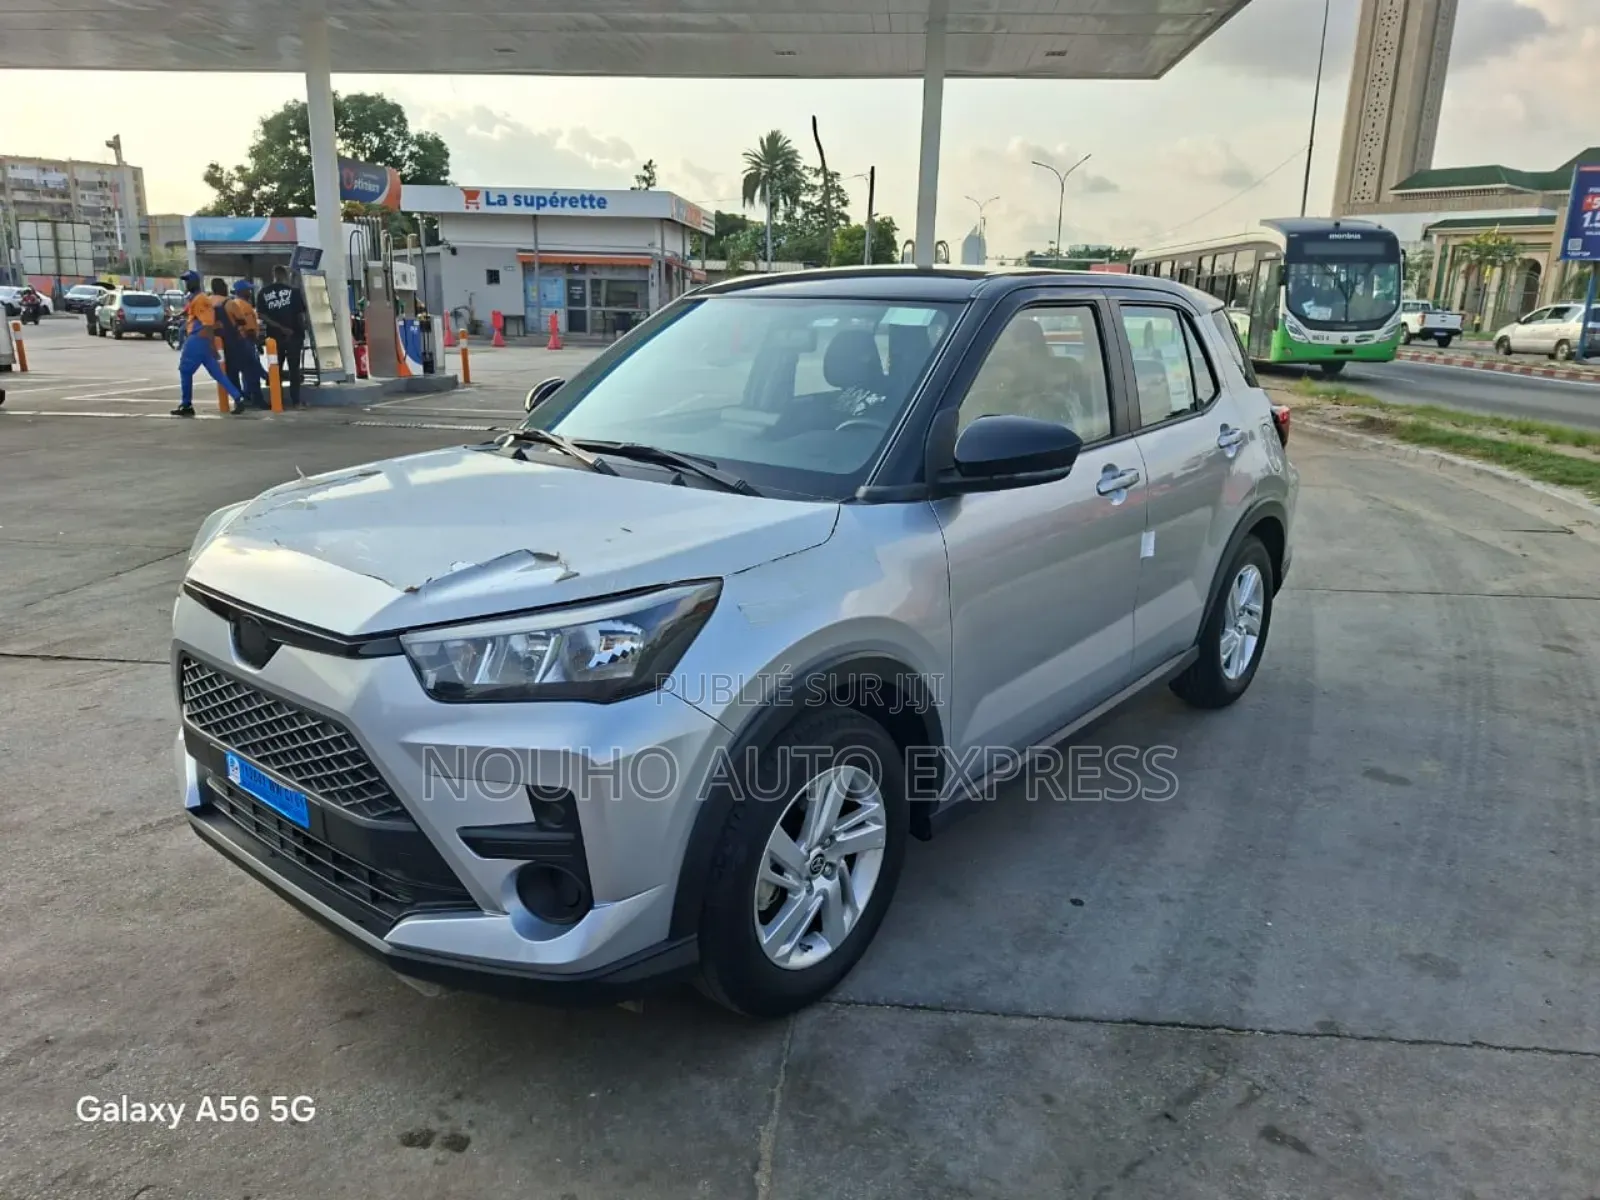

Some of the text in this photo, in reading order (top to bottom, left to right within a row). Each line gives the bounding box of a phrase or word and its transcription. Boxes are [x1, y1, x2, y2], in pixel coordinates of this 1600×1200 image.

[485, 191, 608, 210] La supérette
[1329, 232, 1361, 240] monbus
